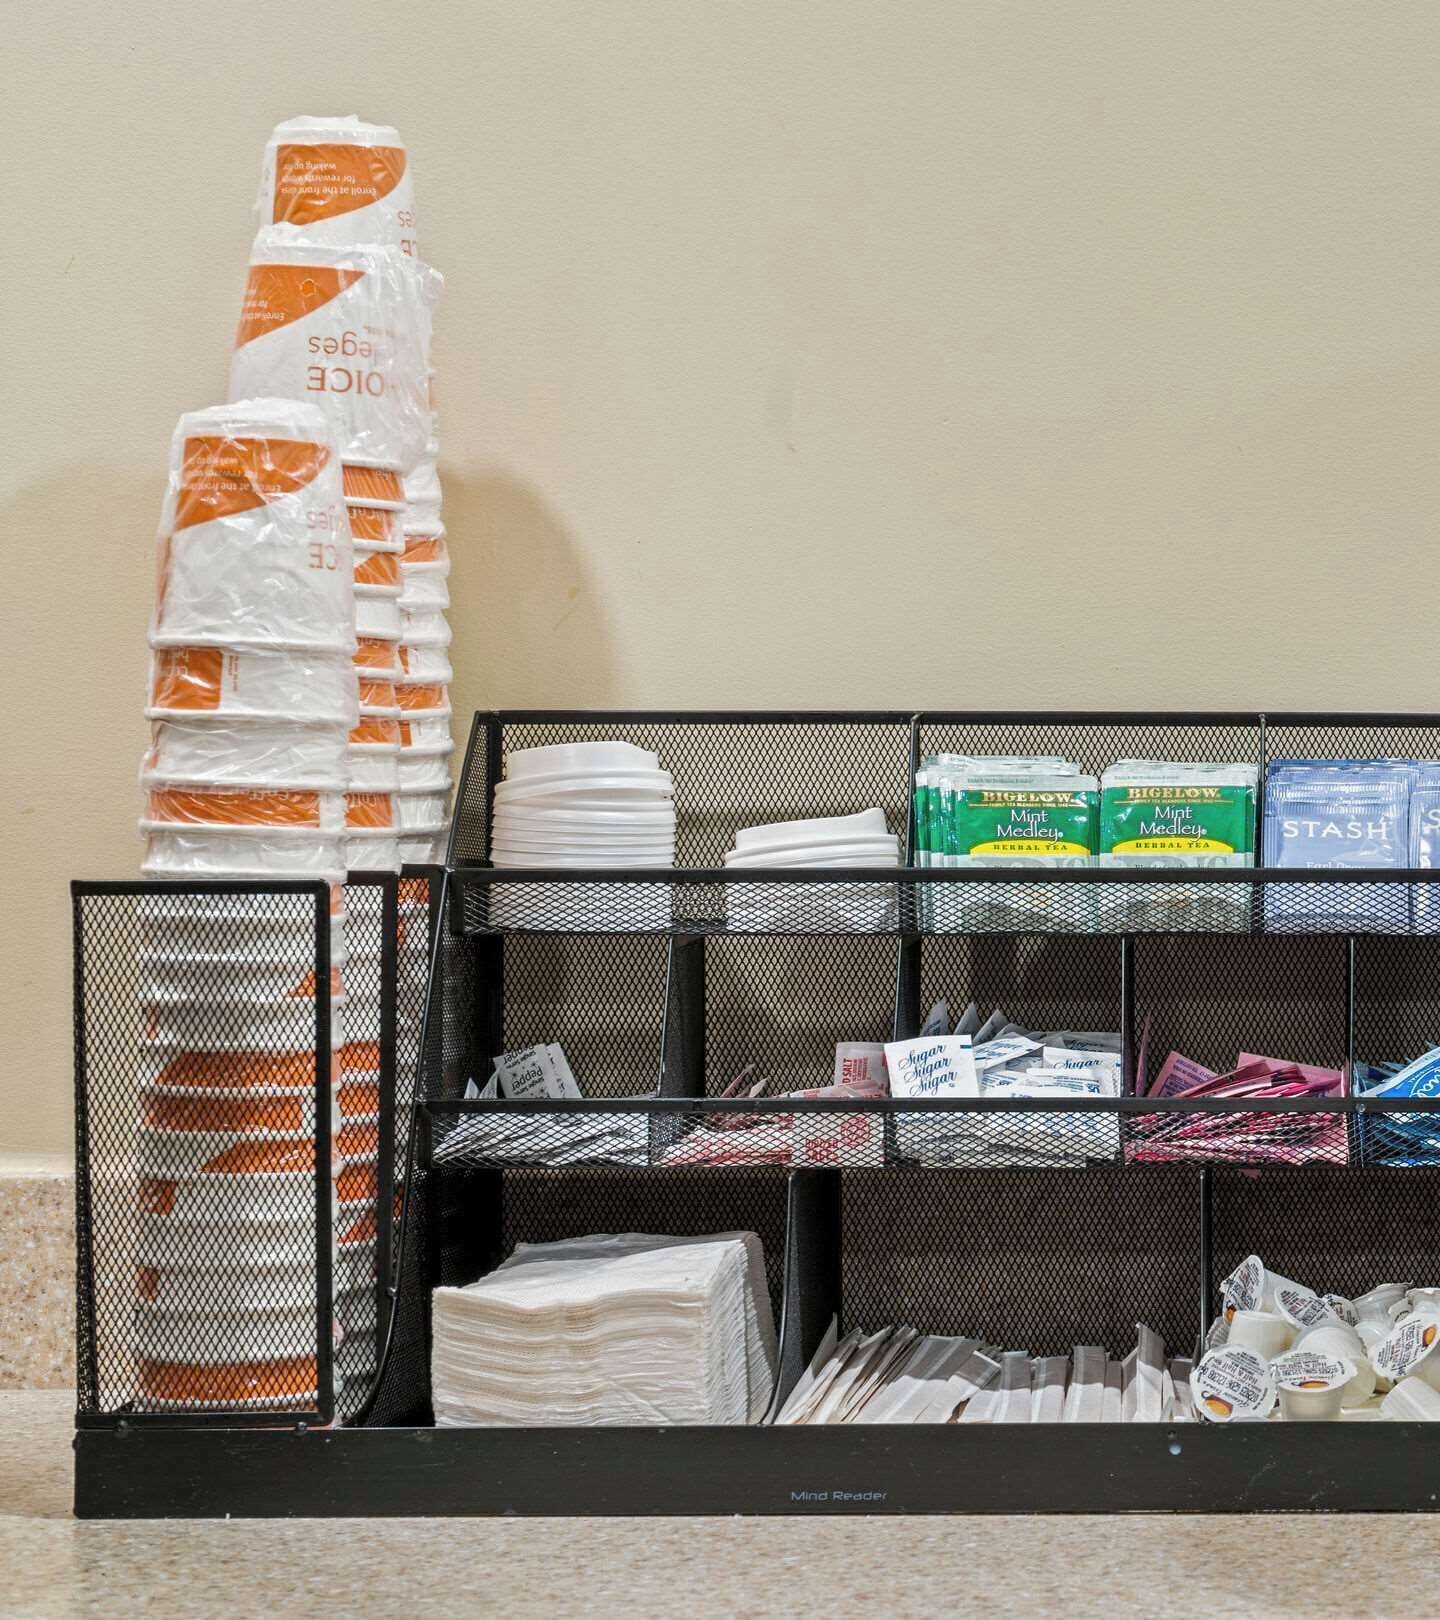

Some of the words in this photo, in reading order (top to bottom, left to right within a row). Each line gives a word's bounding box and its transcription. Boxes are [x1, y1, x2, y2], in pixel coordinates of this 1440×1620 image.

[982, 791, 1073, 802] BIGELOW
[1127, 787, 1220, 799] BIGELOW
[1011, 809, 1049, 823] Mint
[1155, 805, 1193, 819] Mint
[1282, 820, 1388, 839] STASH
[993, 843, 1041, 851] HERBAL
[1045, 843, 1068, 851] TEA
[898, 1044, 947, 1070] Sugar
[1054, 1058, 1104, 1070] Sugar
[842, 1058, 853, 1077] SALT
[903, 1057, 953, 1083] Sugar
[909, 1071, 959, 1097] Sugar
[791, 1491, 828, 1501] Mind
[833, 1490, 888, 1501] Reader
